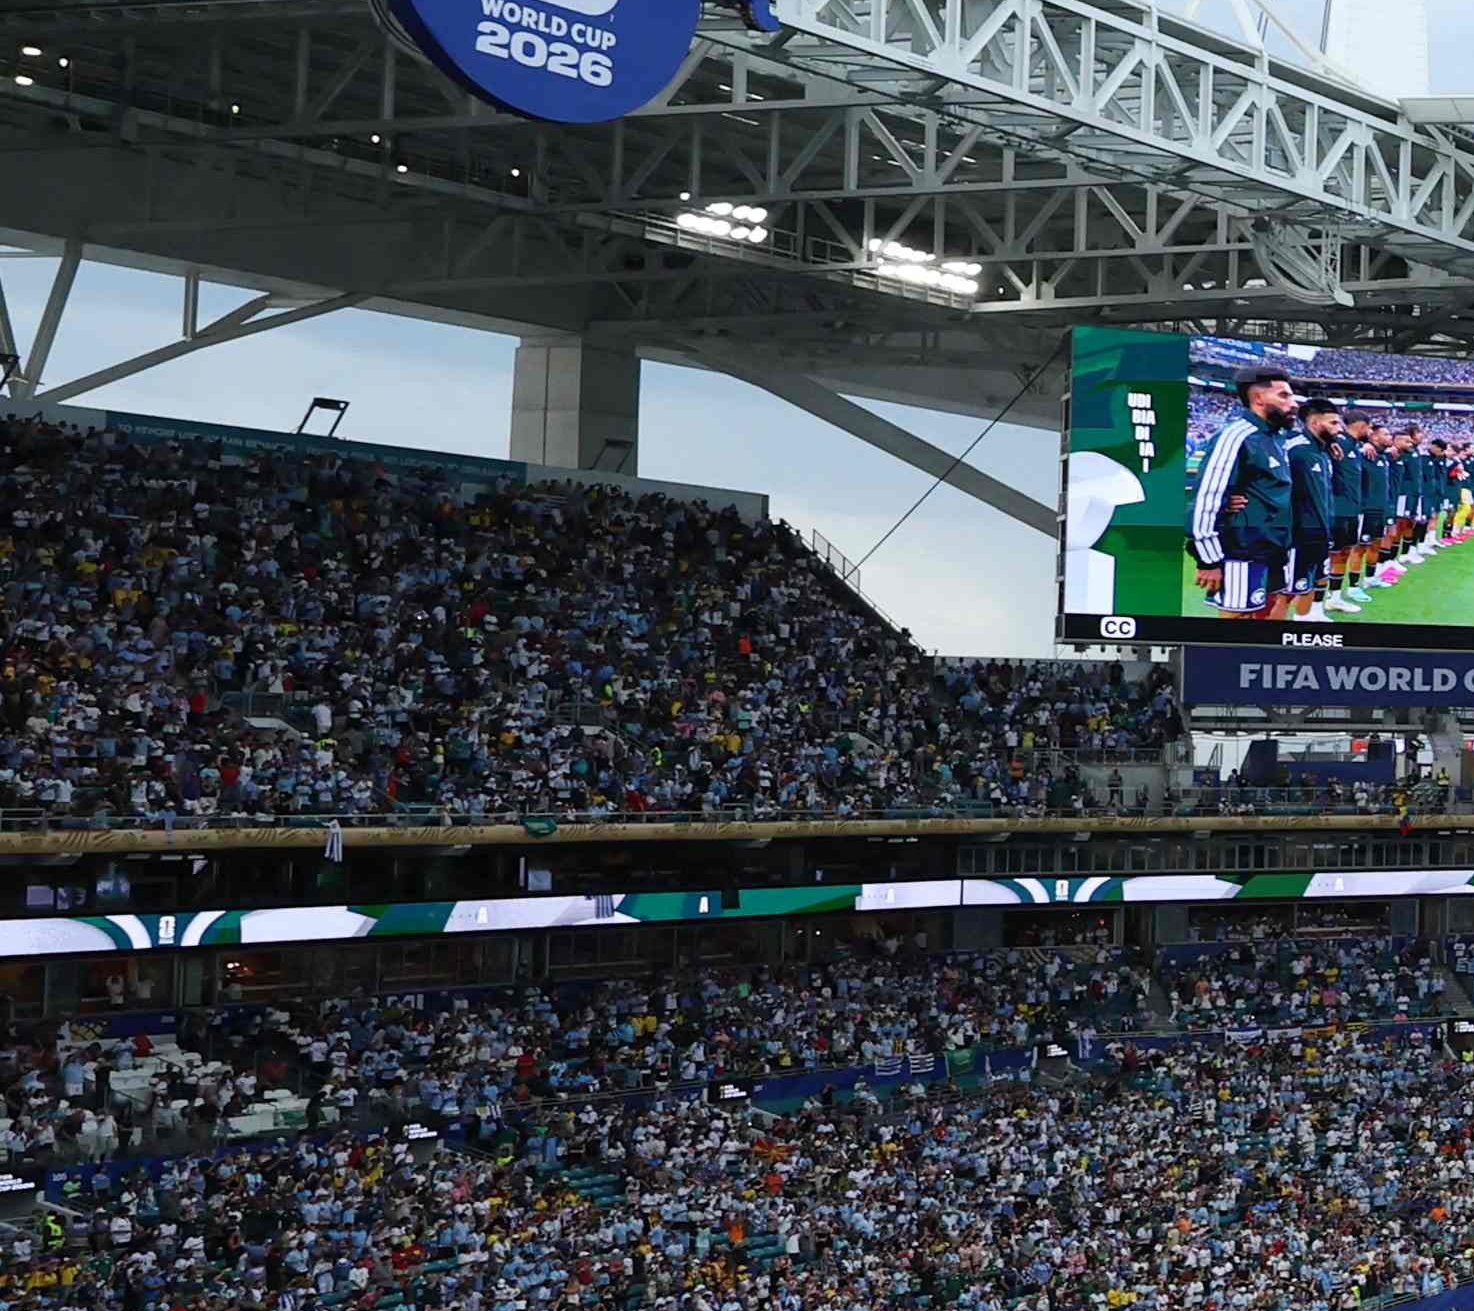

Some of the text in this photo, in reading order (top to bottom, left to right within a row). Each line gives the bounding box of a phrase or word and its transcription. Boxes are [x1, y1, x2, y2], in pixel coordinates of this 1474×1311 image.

[570, 21, 617, 51] CUP
[475, 21, 614, 88] 2026
[1104, 620, 1132, 636] CC
[1283, 633, 1343, 647] PLEASE
[1240, 662, 1319, 690] FIFA
[1326, 665, 1456, 693] WORLD
